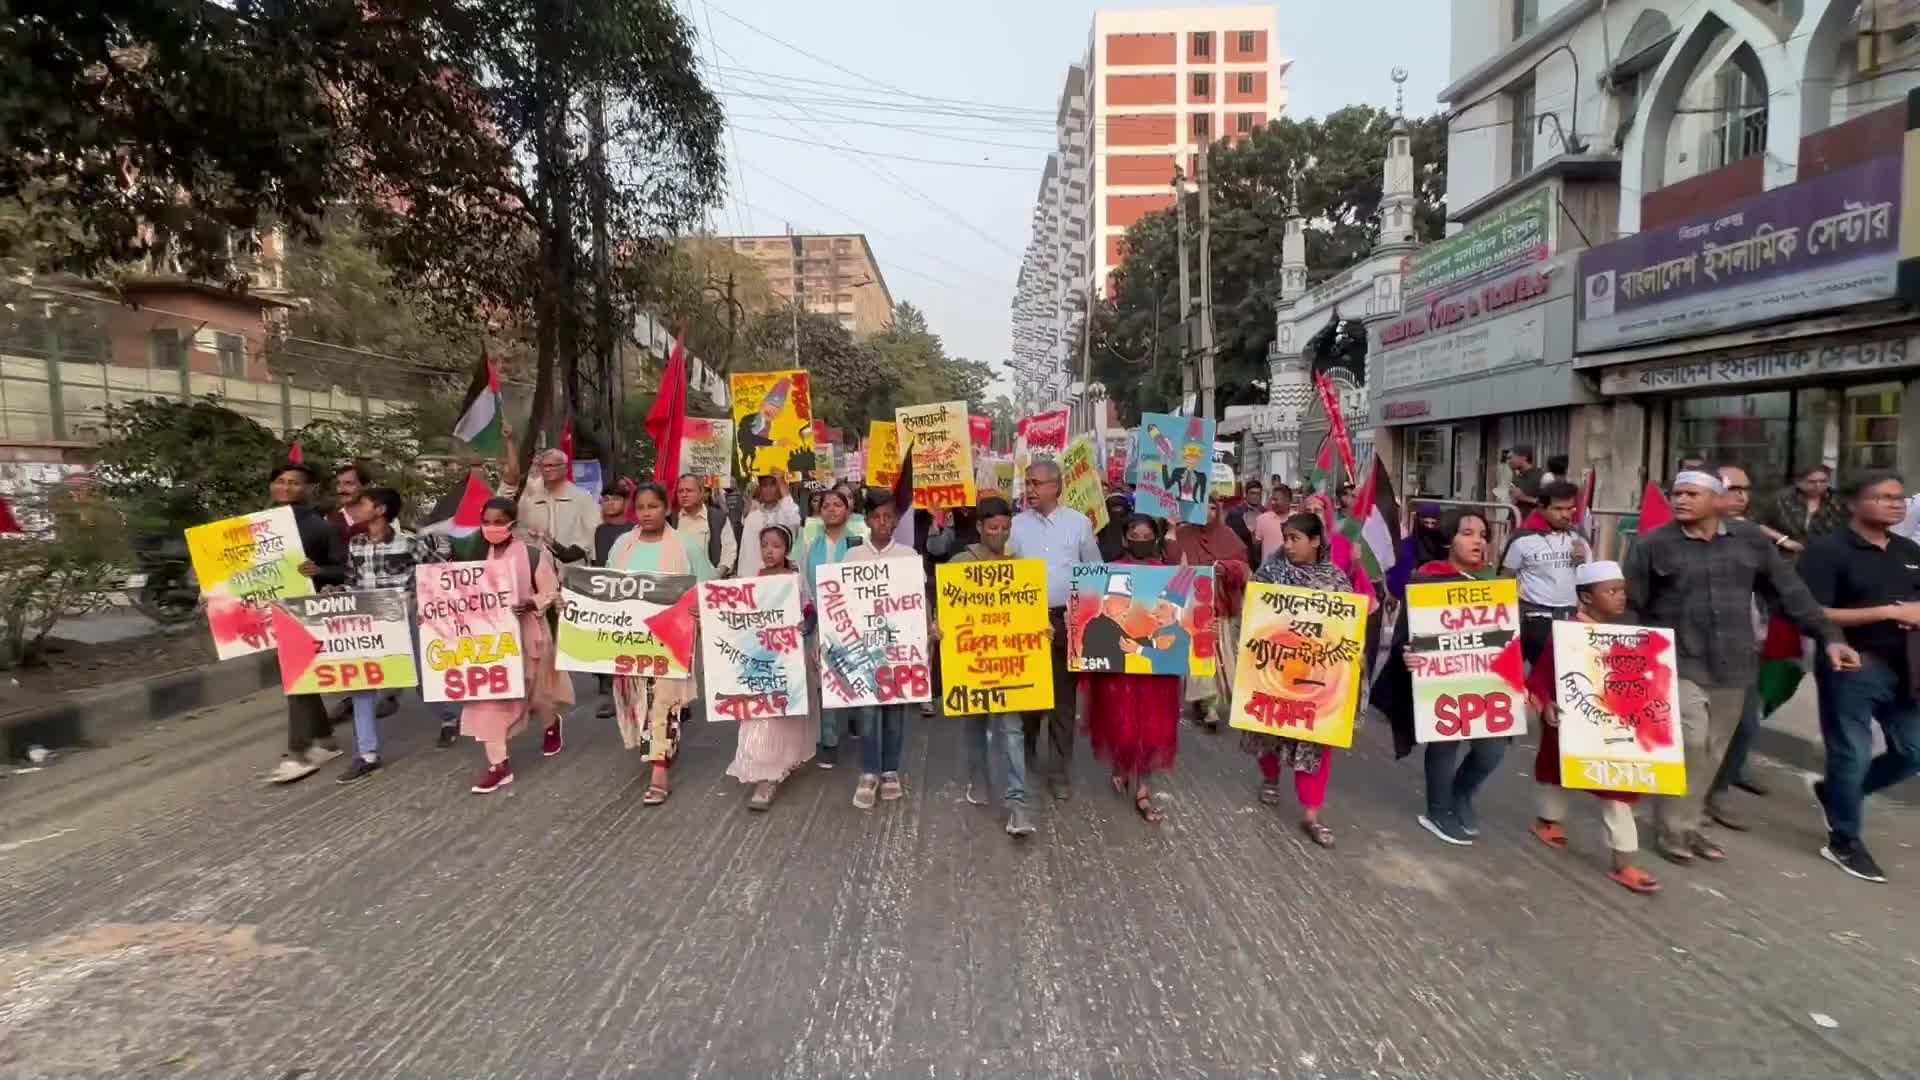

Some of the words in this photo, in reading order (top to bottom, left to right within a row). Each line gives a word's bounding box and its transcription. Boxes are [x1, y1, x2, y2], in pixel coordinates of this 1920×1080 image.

[1619, 252, 1699, 300] বাংলাদেশ
[1703, 222, 1800, 282] ইসলামিক
[1807, 200, 1893, 254] সেন্টার
[440, 567, 485, 590] STOP
[841, 563, 889, 583] FROM
[964, 563, 1015, 587] গাজায়
[1072, 566, 1109, 577] DOWN
[590, 575, 656, 599] STOP
[854, 584, 889, 600] THE
[1446, 586, 1492, 605] FREE
[305, 594, 357, 616] DOWN
[423, 592, 510, 620] GENOCIDE
[563, 599, 633, 627] Genocide
[873, 593, 922, 615] RIVER
[324, 613, 373, 633] WITH
[817, 580, 875, 673] PALESTINE
[863, 613, 888, 629] TO
[1440, 602, 1511, 630] GAZA
[454, 621, 471, 637] in
[863, 629, 900, 647] THE
[1287, 619, 1323, 638] হবে
[315, 634, 385, 654] ZIONISM
[426, 631, 520, 671] GAZA
[1438, 631, 1485, 650] FREE
[614, 654, 669, 676] SPB
[885, 645, 923, 662] SEA
[314, 661, 385, 688] SPB
[444, 664, 509, 700] SPB
[874, 664, 930, 702] SPB
[850, 677, 873, 699] BE
[946, 684, 1020, 713] বাসদ
[715, 691, 790, 721] বাসদ
[1244, 690, 1317, 732] বাসদ
[1434, 691, 1514, 736] SPB
[1576, 759, 1658, 790] বাসদ
